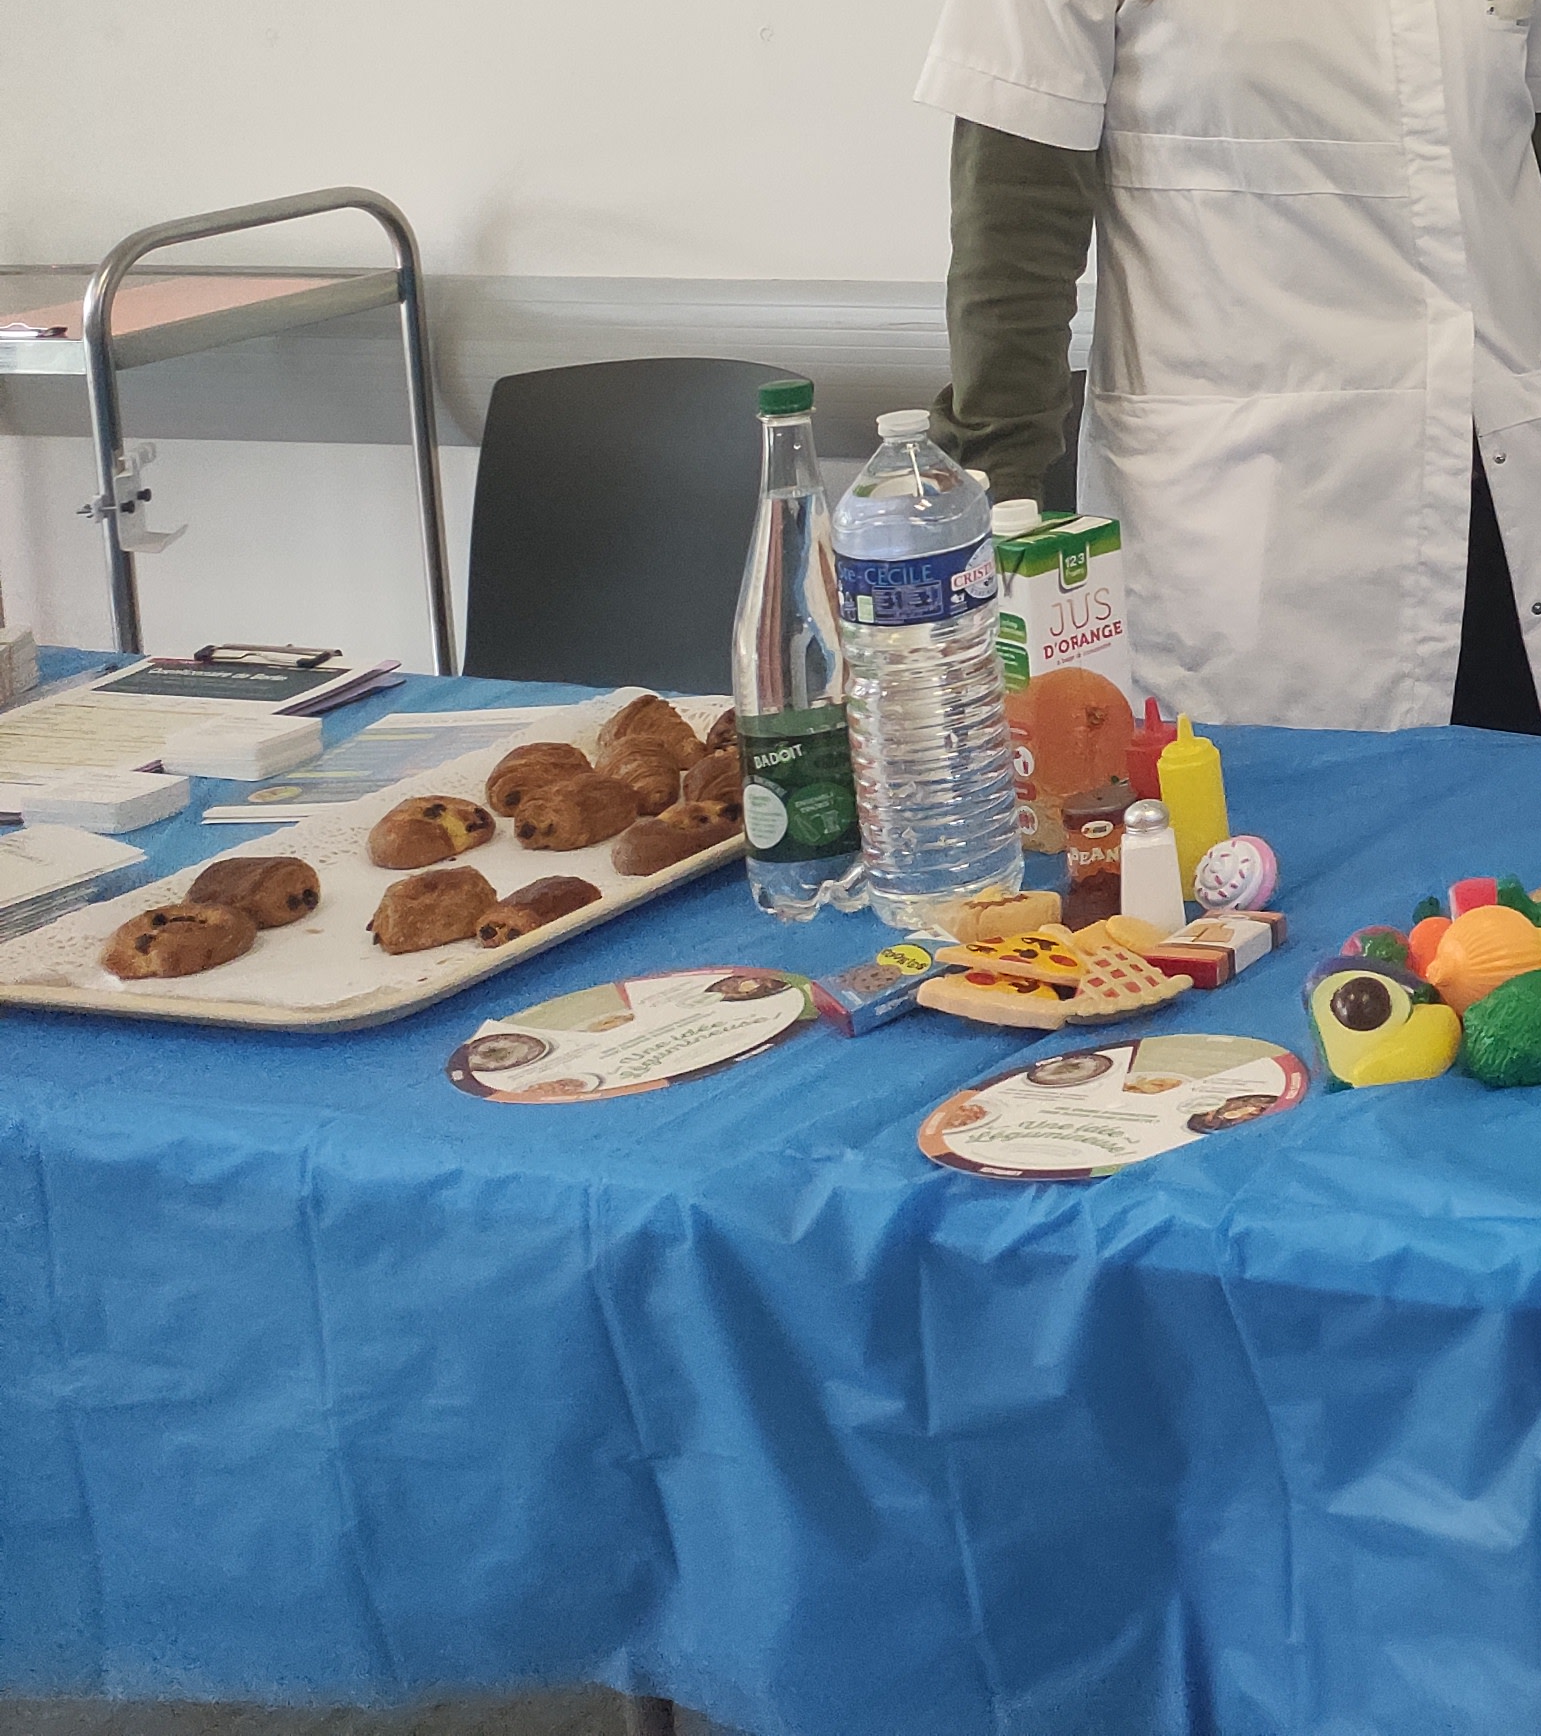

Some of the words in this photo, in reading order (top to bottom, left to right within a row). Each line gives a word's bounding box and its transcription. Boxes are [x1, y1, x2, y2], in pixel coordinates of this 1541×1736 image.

[1050, 587, 1112, 637] JUS
[1043, 620, 1123, 661] D'ORANGE
[754, 743, 803, 770] BADOIT
